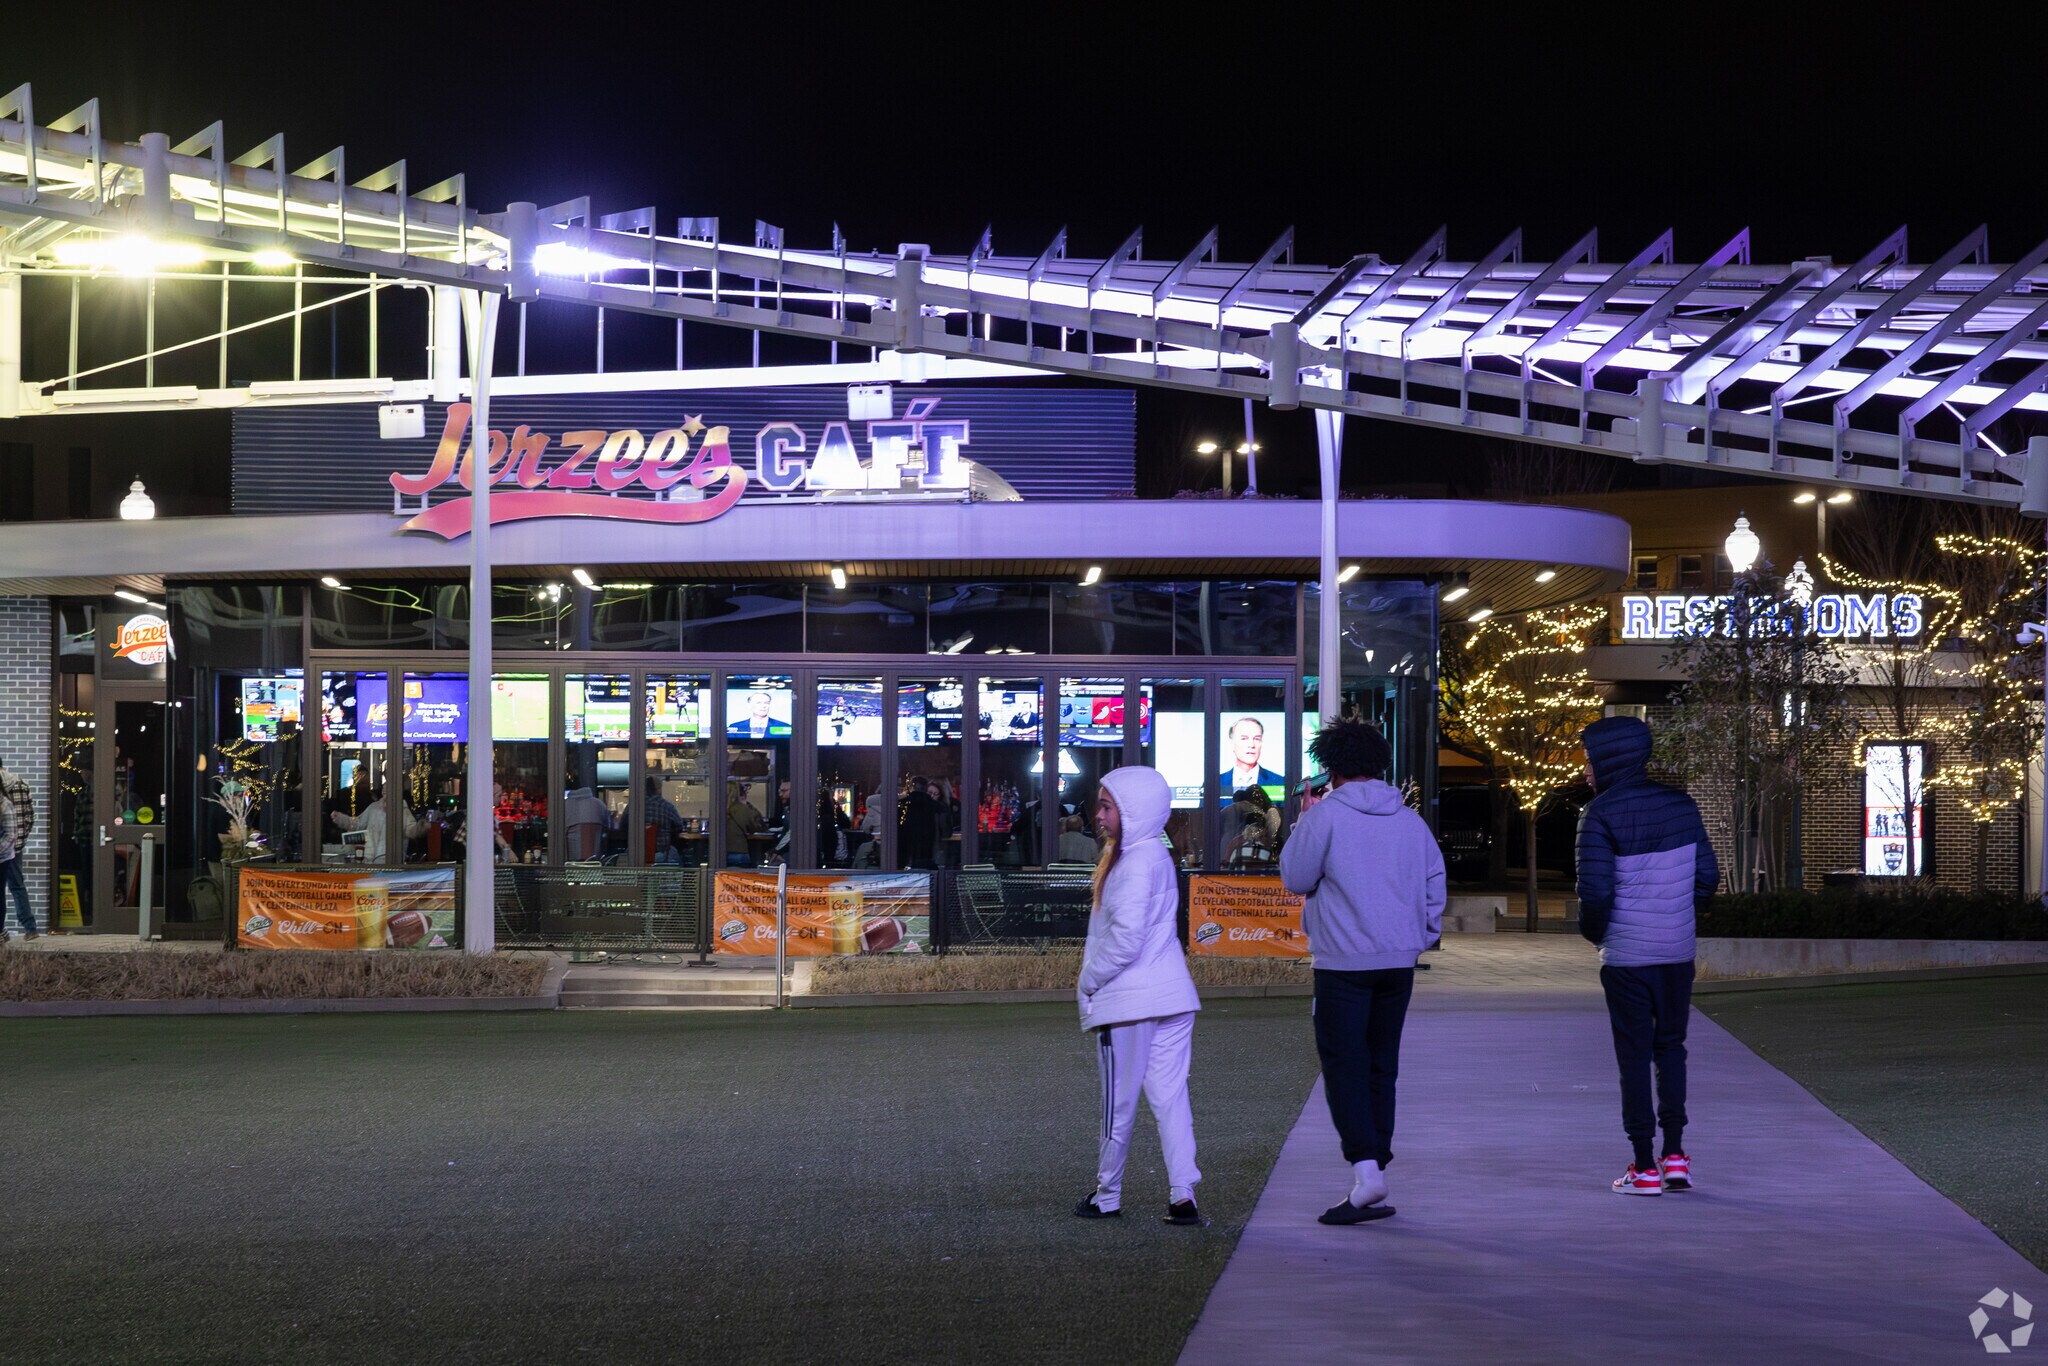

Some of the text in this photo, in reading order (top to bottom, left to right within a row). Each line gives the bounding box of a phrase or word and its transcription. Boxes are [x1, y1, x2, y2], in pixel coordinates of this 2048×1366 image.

[755, 398, 970, 491] CAFÉ
[366, 702, 412, 724] KEO
[247, 879, 263, 887] JOIN
[265, 880, 275, 888] US
[277, 881, 300, 889] EVERY
[333, 882, 349, 890] FOR
[722, 884, 739, 892] JOIN
[242, 889, 352, 900] CLEVELAND FOOTBALL GAMES
[1197, 886, 1213, 894] JOIN
[1216, 887, 1225, 895] US
[1227, 887, 1251, 895] EVERY
[1252, 887, 1281, 896] SUNDAY
[718, 895, 827, 905] CLEVELAND FOOALL GAMES
[1193, 897, 1302, 907] CLEVELAND FOOTBALL GAMES
[315, 903, 338, 911] PLAZA
[742, 907, 788, 915] CENTENNL
[1206, 908, 1288, 918] AT CENTENNIAL PLAZA
[278, 920, 318, 935] Chill
[753, 925, 792, 939] Chil
[1229, 927, 1268, 941] Chill
